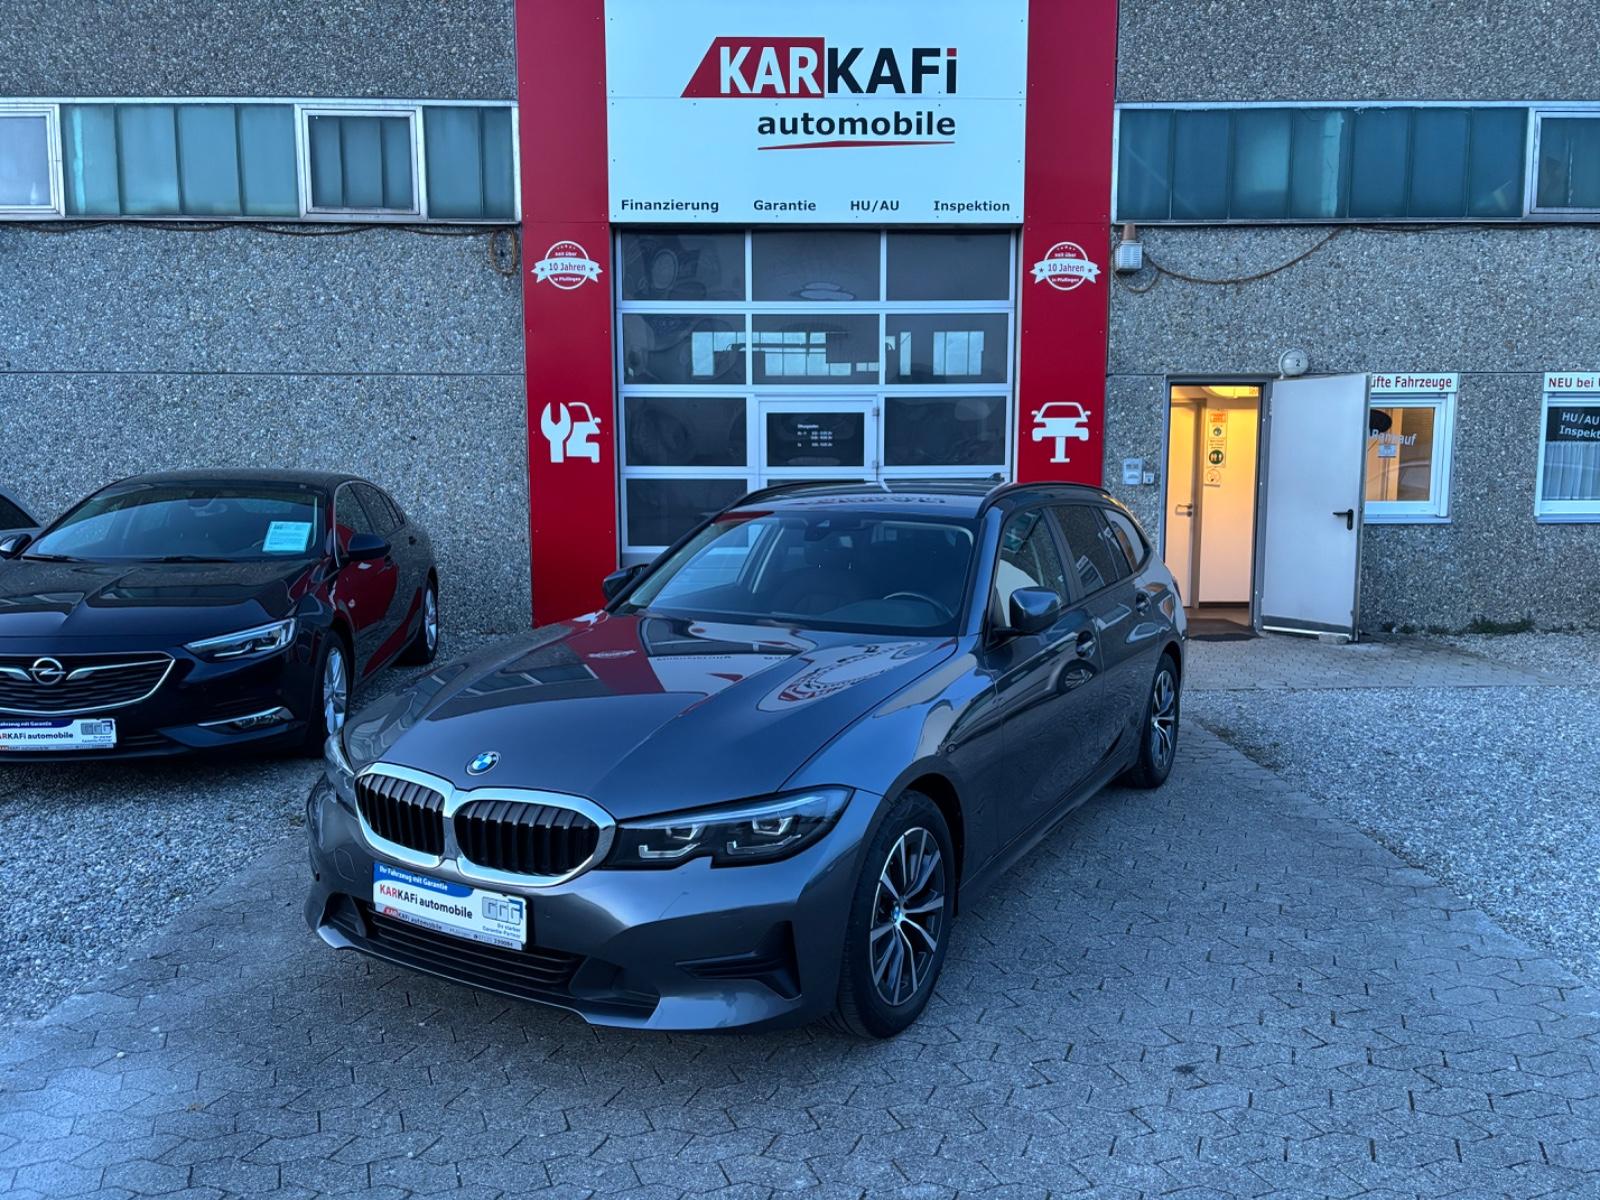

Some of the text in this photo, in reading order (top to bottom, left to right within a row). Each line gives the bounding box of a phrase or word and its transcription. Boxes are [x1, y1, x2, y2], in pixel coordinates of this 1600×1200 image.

[719, 46, 957, 94] KARKAFi
[757, 111, 956, 136] automobile
[621, 199, 719, 213] Finanzierung
[753, 199, 817, 212] Garantie
[850, 199, 900, 213] HU/AU
[933, 199, 1010, 213] Inspektion
[549, 262, 586, 271] 10 Jahren
[1048, 264, 1085, 272] 10 Jahren
[1394, 376, 1452, 390] Fahrzeuge
[1548, 378, 1572, 388] NEU
[1576, 376, 1594, 388] bei
[1562, 412, 1600, 426] HU/AU
[422, 878, 448, 890] Garantie
[380, 884, 472, 919] KARKAFi automobile
